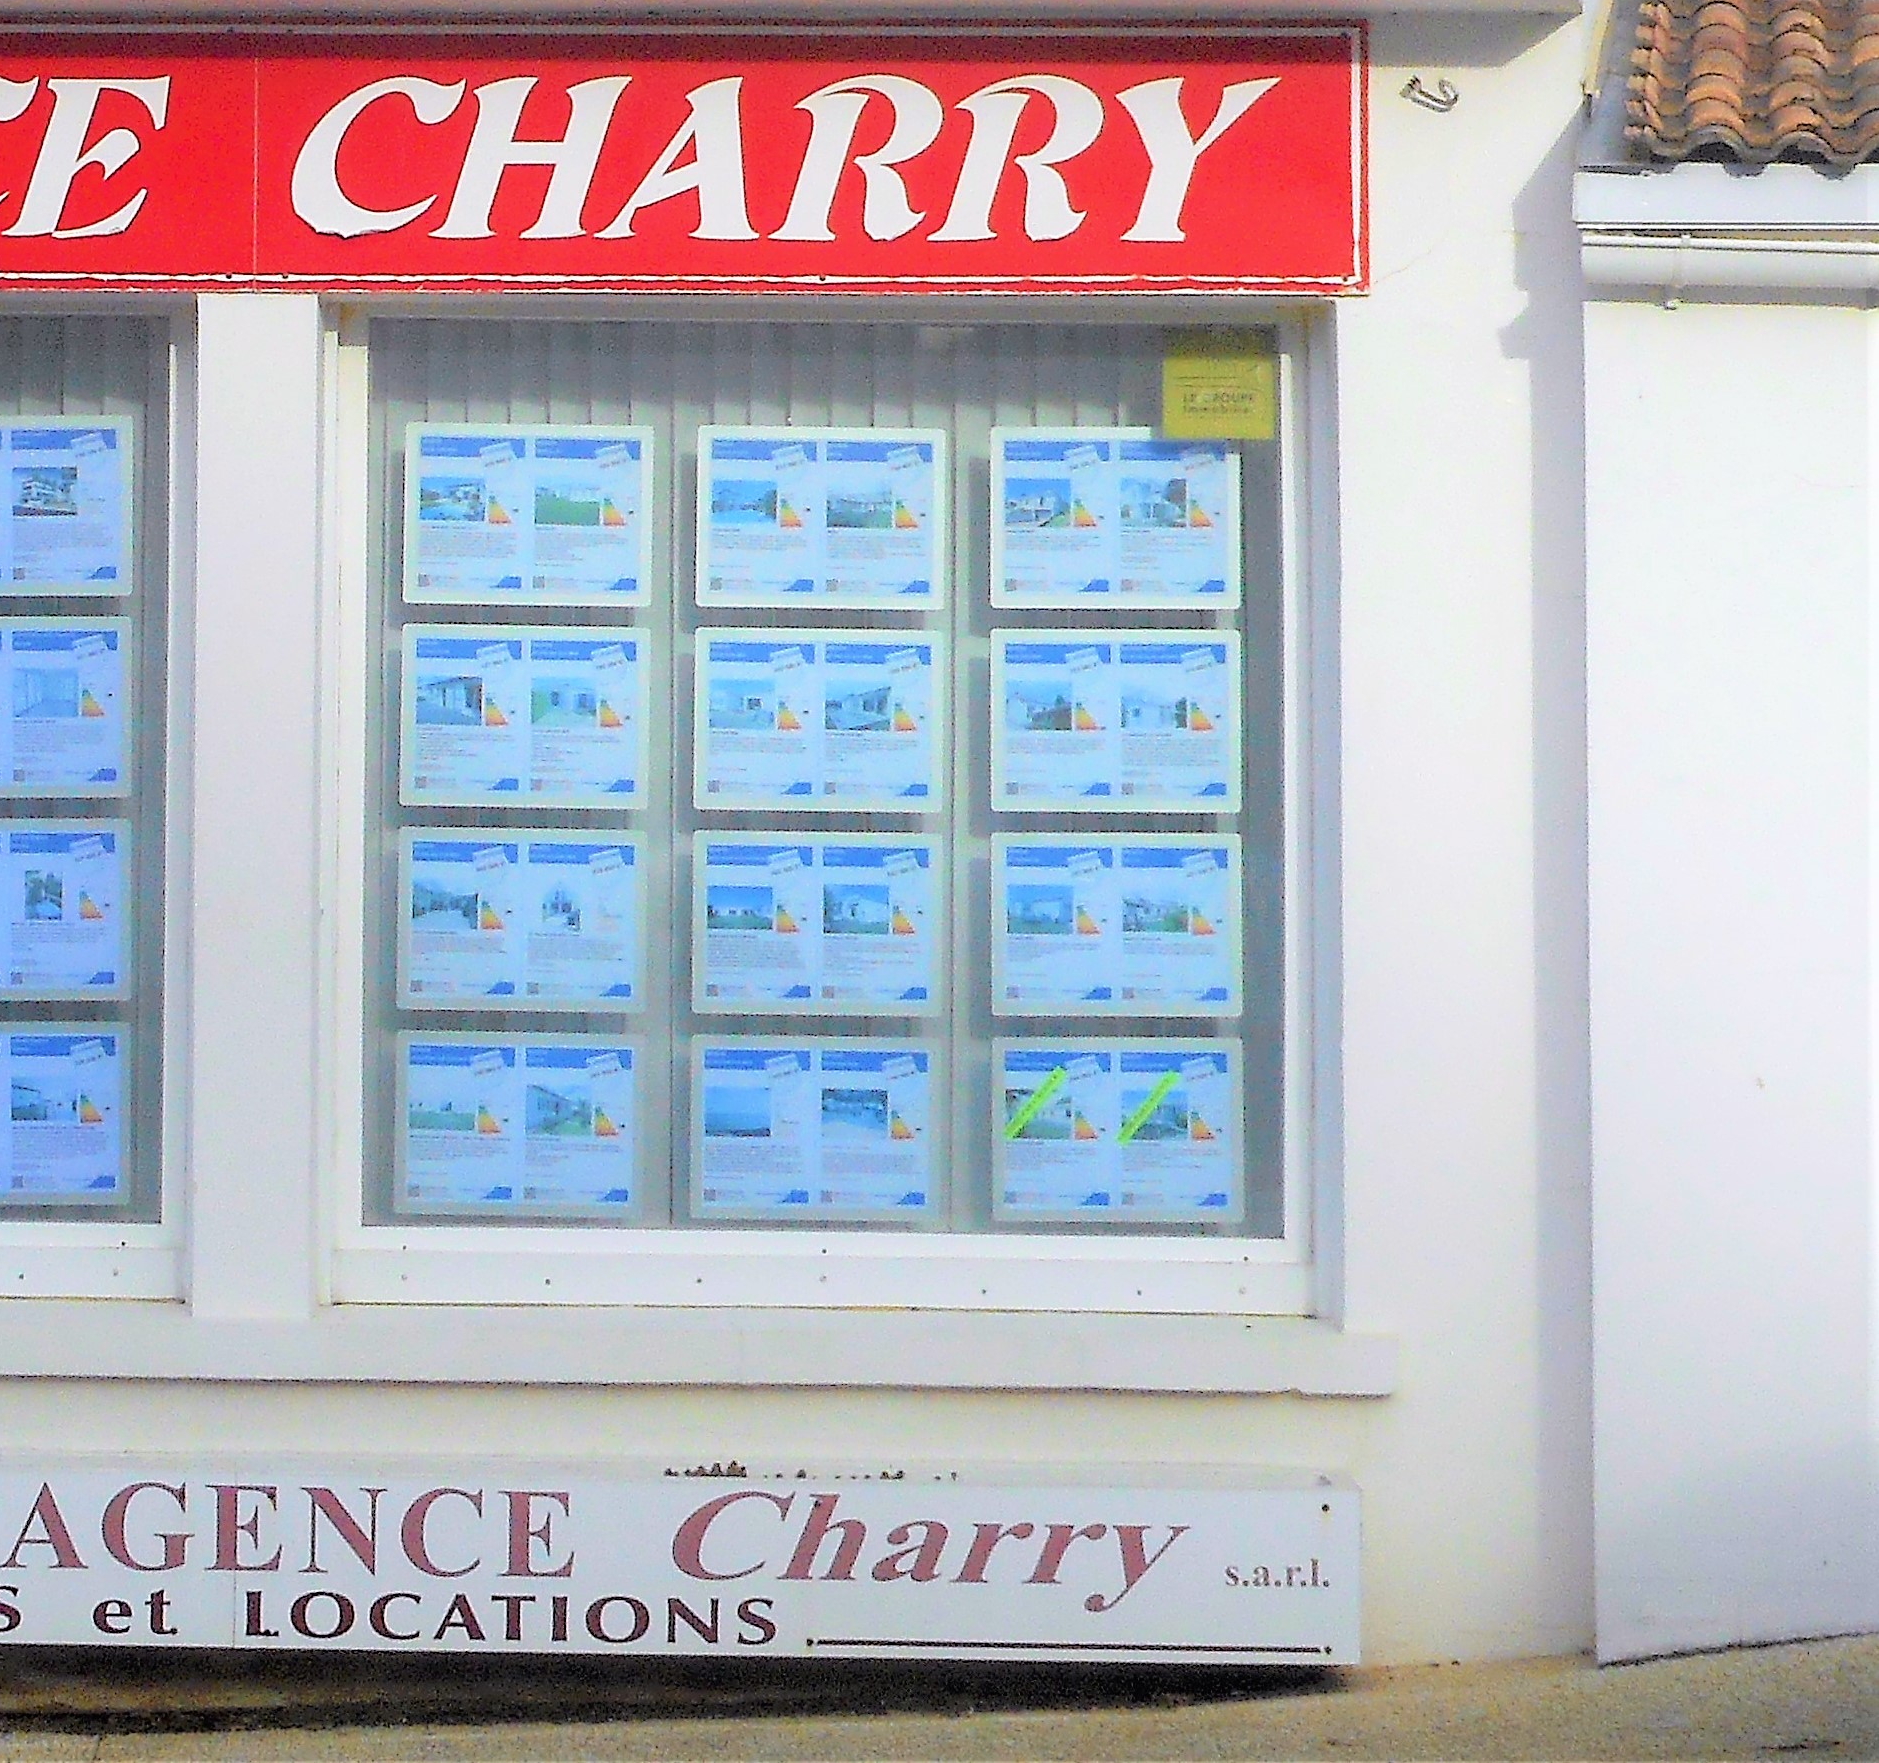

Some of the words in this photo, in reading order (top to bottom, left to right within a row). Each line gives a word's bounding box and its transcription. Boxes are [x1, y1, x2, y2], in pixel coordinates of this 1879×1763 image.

[290, 73, 1282, 244] CHARRY
[671, 1489, 1192, 1614] Charry
[1223, 1558, 1331, 1589] s.a.r.l.
[92, 1588, 179, 1637] et
[245, 1590, 778, 1647] LOCATIONS
